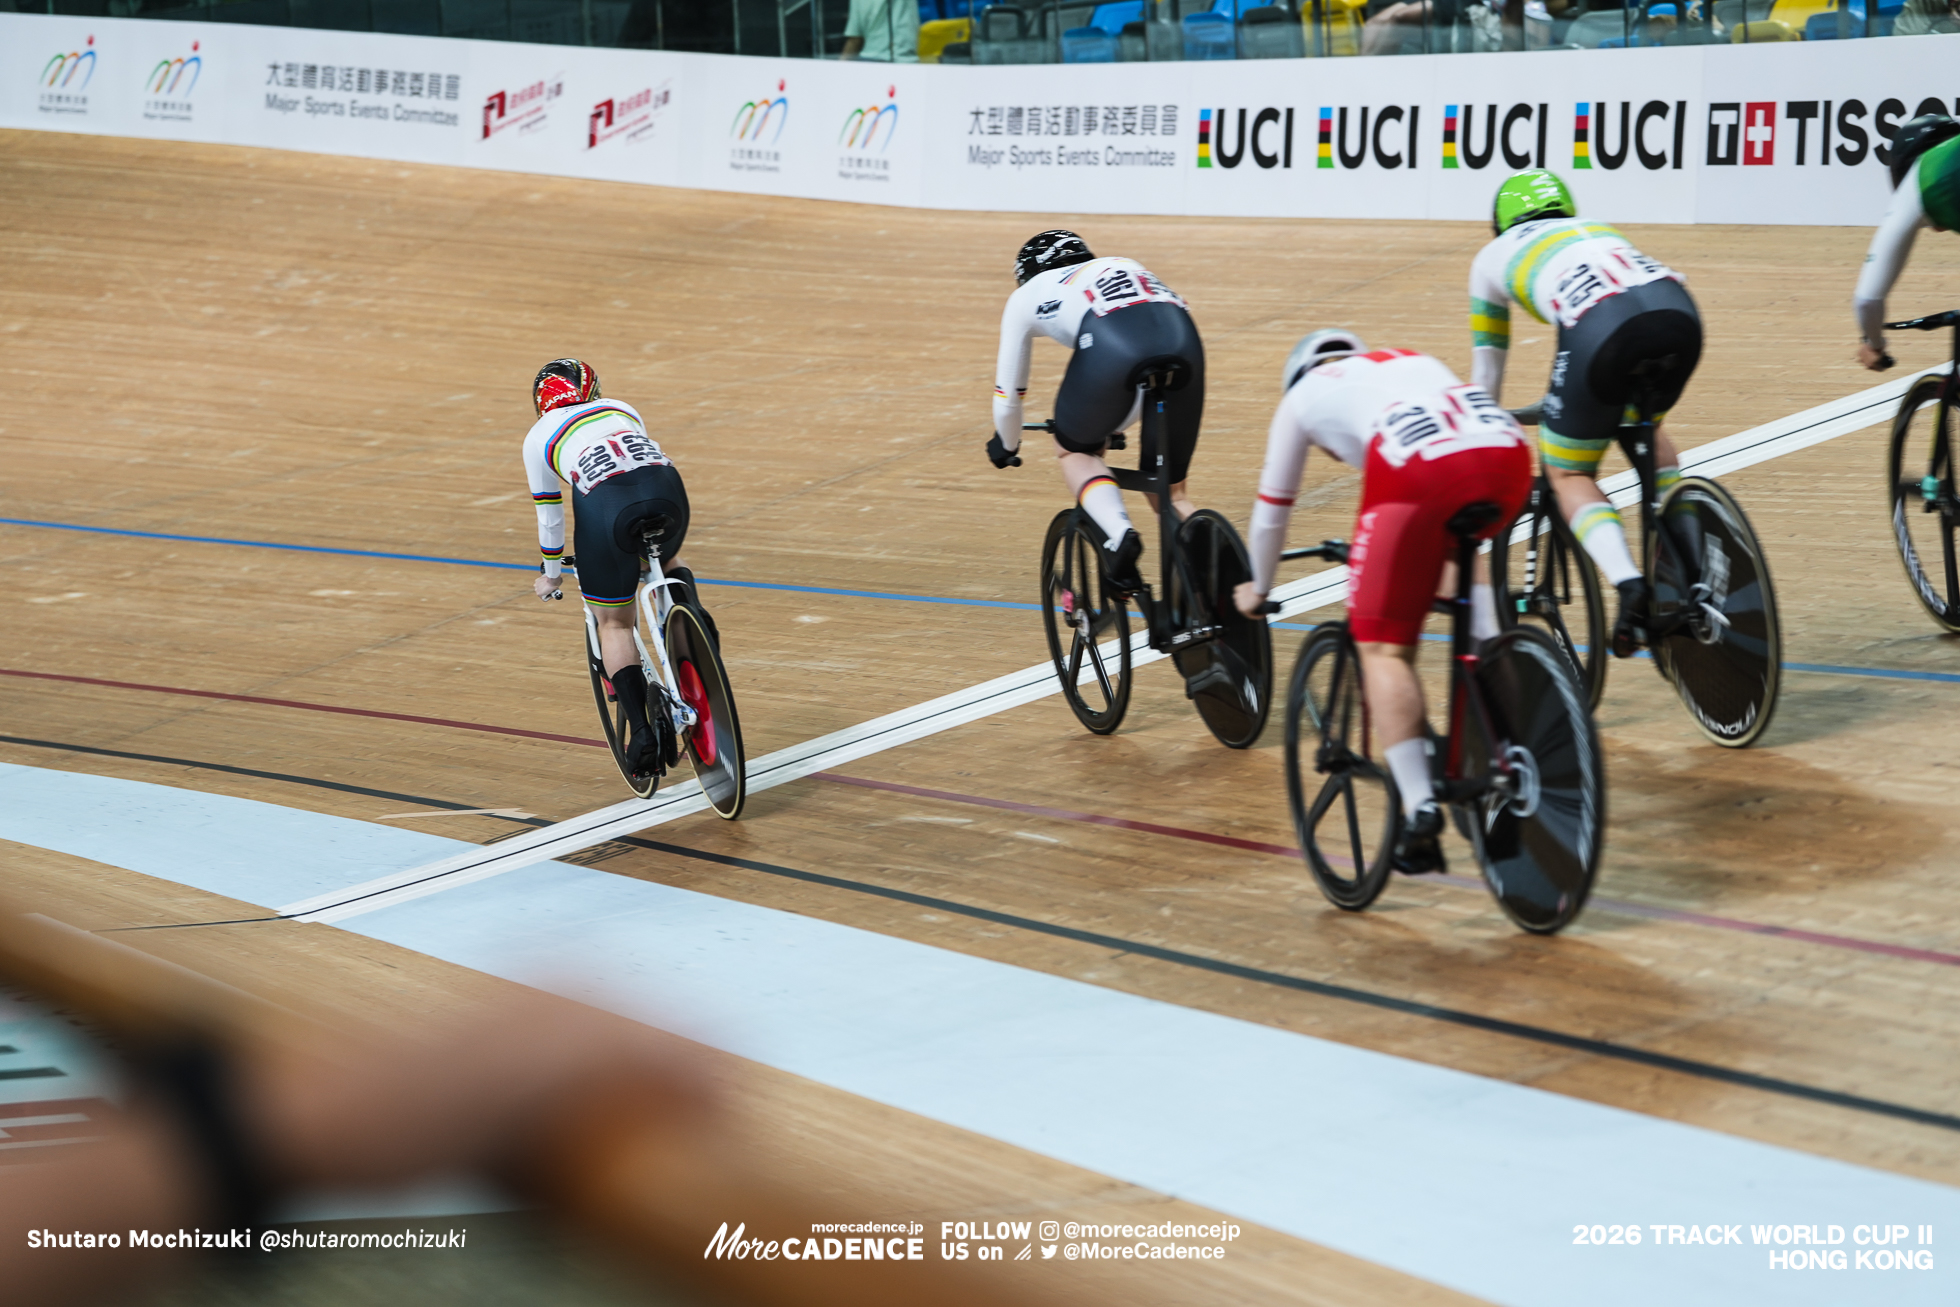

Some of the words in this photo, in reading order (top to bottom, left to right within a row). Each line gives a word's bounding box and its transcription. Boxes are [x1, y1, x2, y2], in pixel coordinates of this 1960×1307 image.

[968, 145, 1004, 168] Major
[1009, 145, 1052, 170] Sports
[1057, 145, 1100, 165] Events
[1105, 146, 1176, 166] Committee
[1215, 108, 1294, 169] UCI
[1338, 105, 1420, 169] UCI
[1462, 103, 1548, 170] UCI
[1594, 100, 1687, 170] UCI
[1786, 97, 1960, 167] TISS
[544, 389, 578, 410] JAPAN
